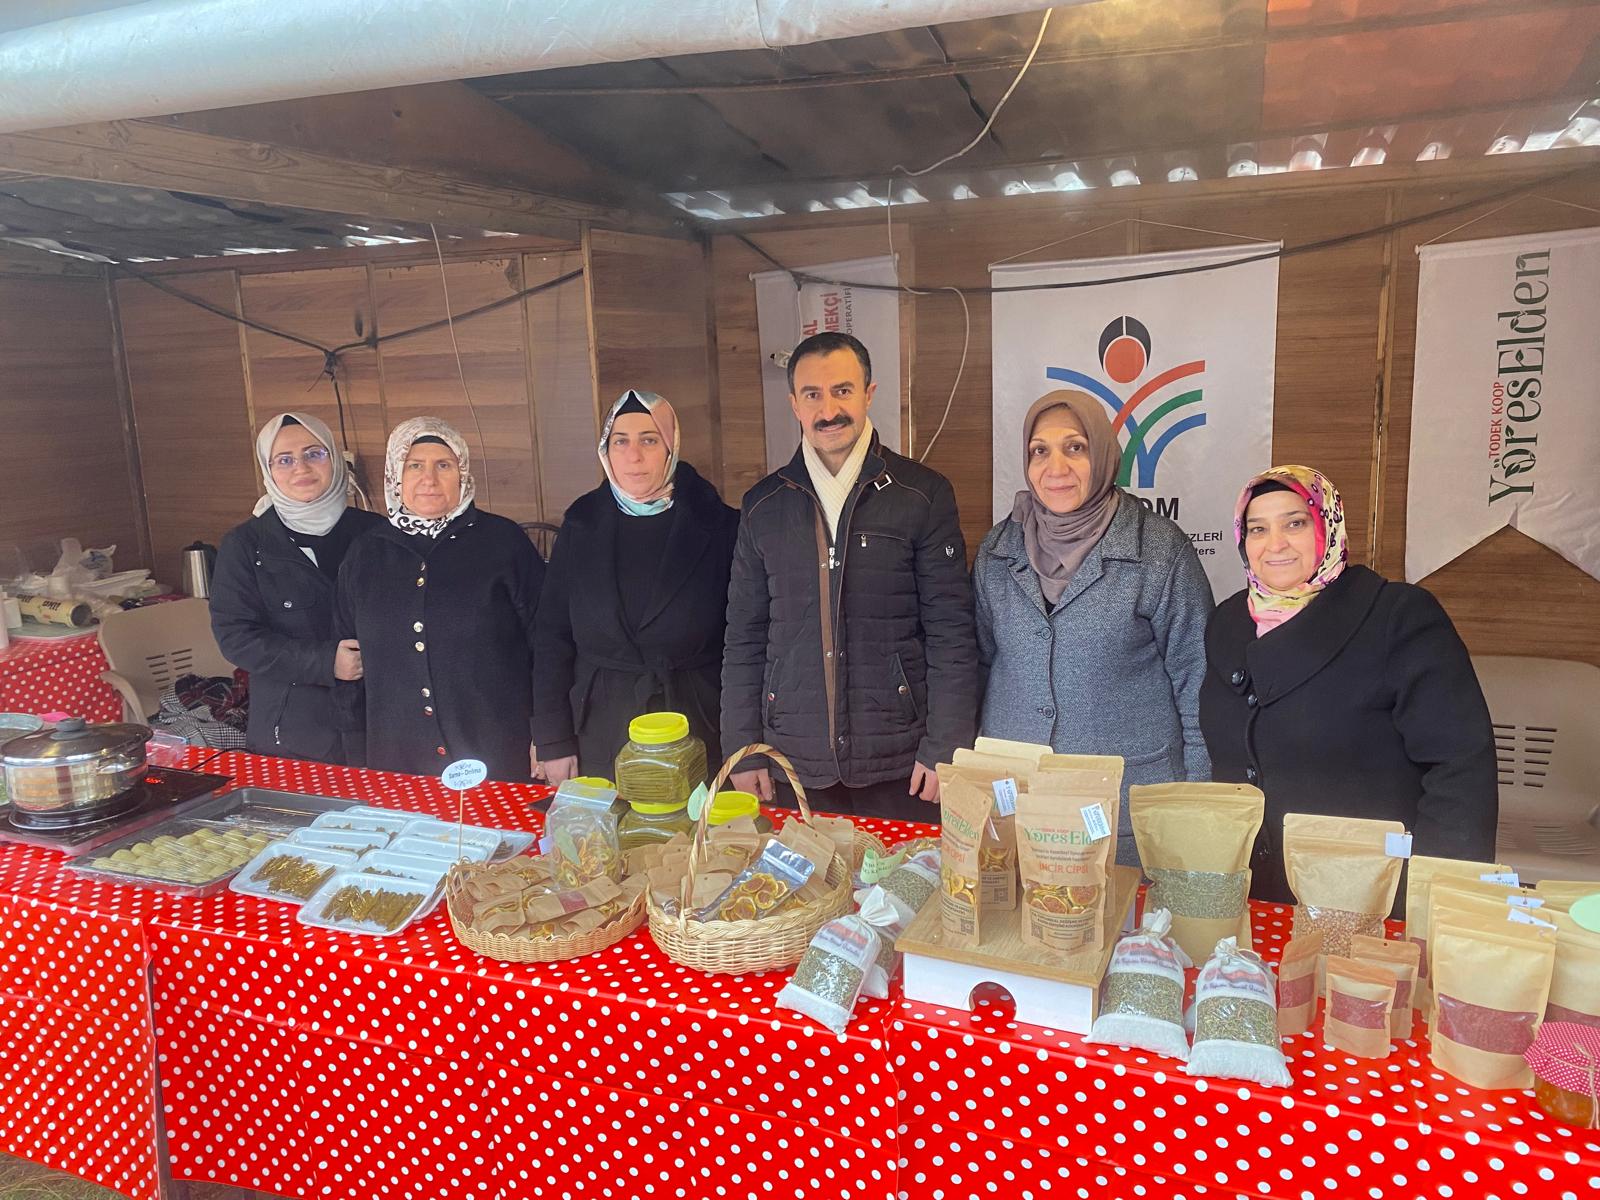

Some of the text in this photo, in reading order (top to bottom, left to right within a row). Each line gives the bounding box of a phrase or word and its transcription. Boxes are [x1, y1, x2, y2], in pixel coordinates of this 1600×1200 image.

[802, 319, 818, 336] AL
[820, 292, 842, 332] MEKÇİ
[843, 287, 853, 335] OPERATİFİ
[1492, 382, 1505, 415] KOOP
[1186, 531, 1223, 543] ZLERİ
